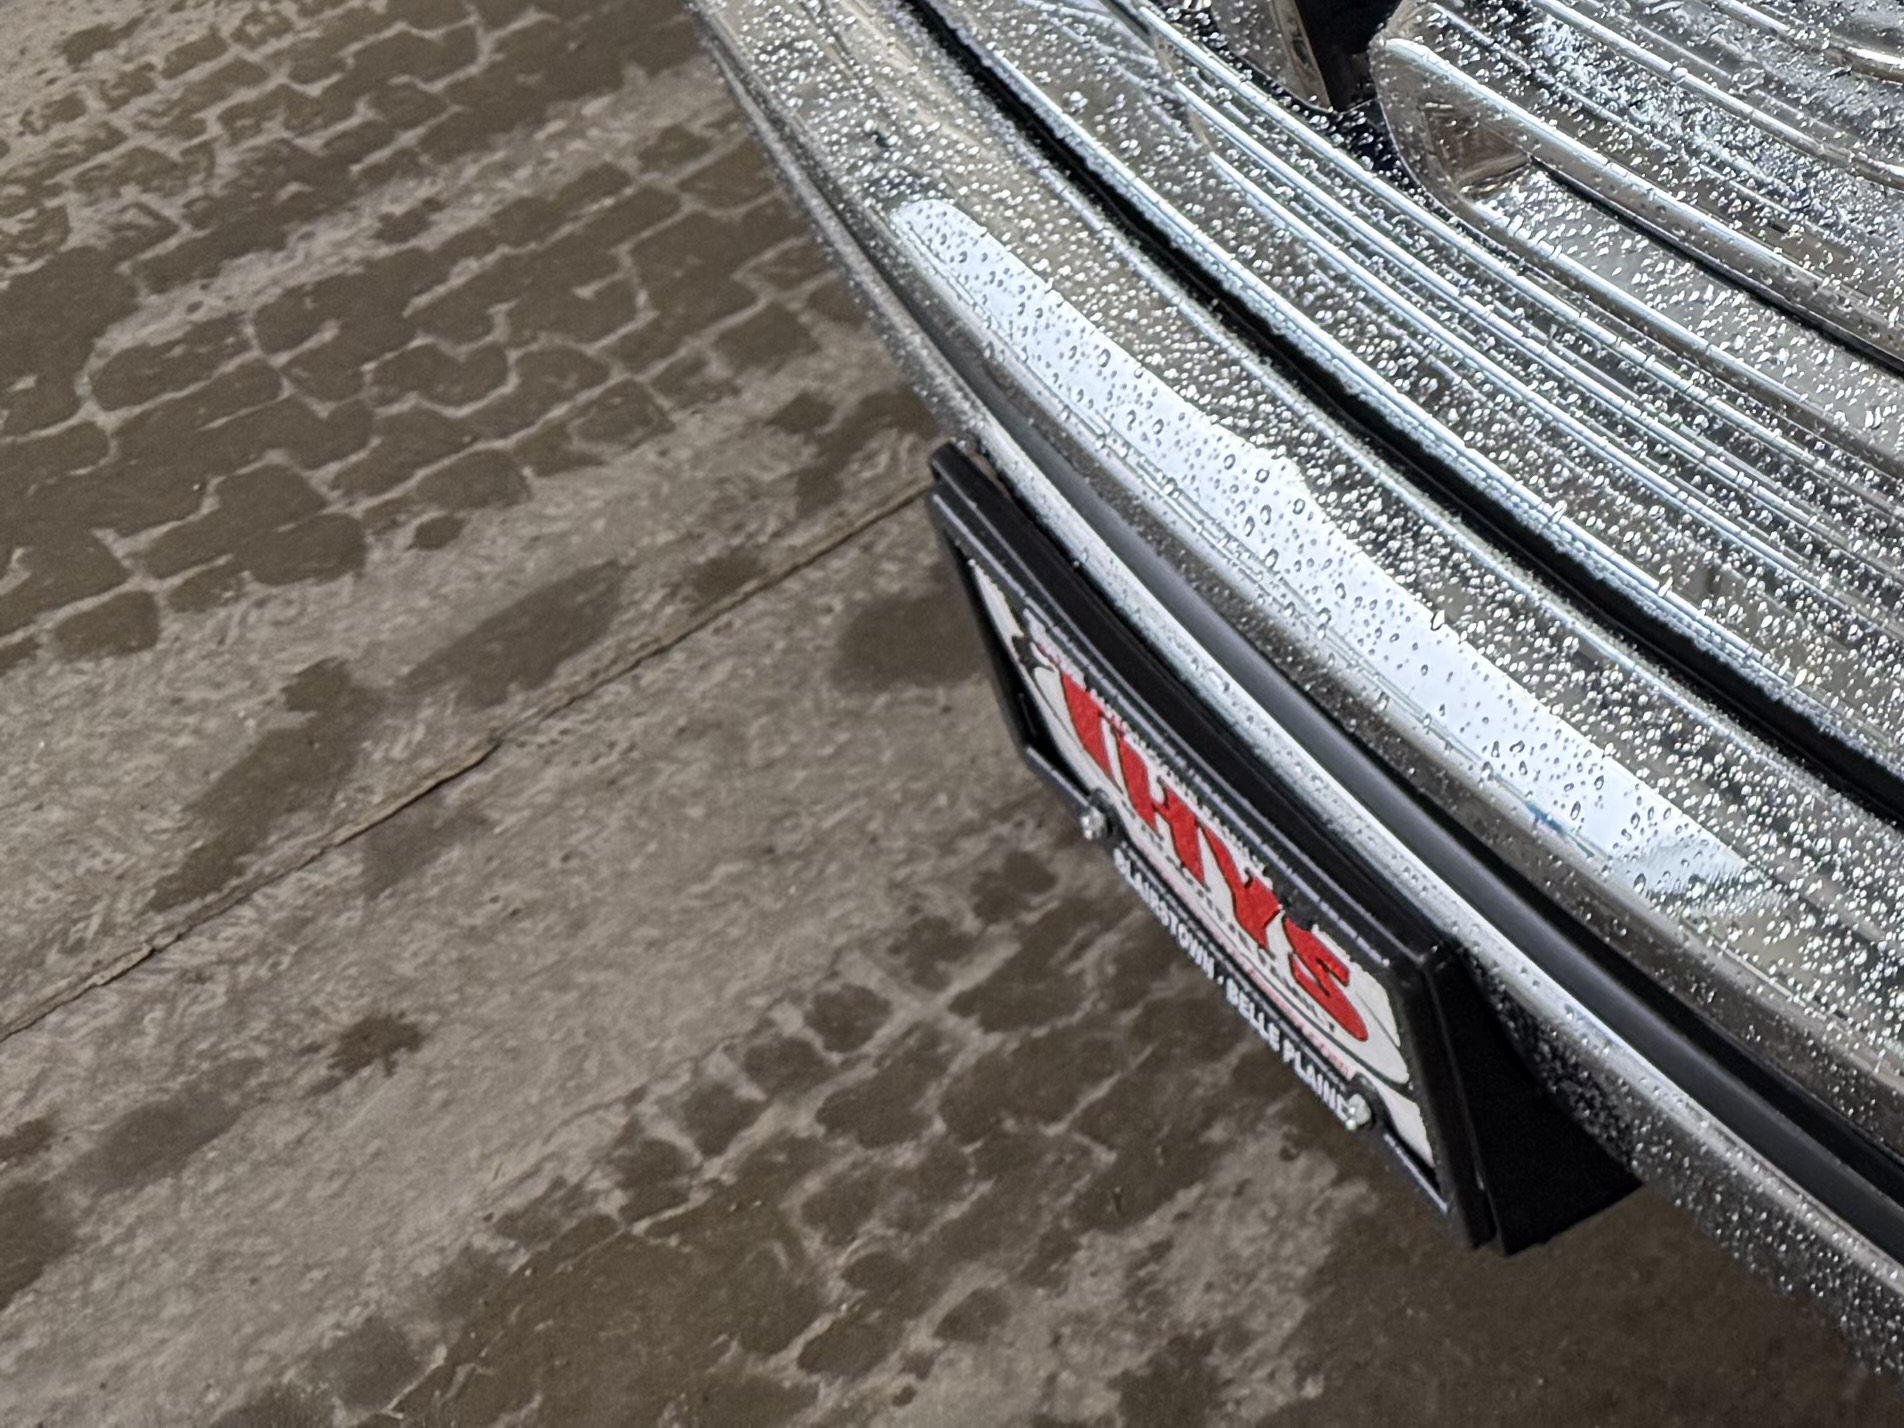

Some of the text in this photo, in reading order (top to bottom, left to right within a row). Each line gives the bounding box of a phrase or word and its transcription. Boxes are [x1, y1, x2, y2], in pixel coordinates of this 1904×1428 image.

[1060, 671, 1368, 1042] THYS
[1113, 846, 1215, 981] BLAIRSTOWN
[1226, 979, 1281, 1053] BELLE
